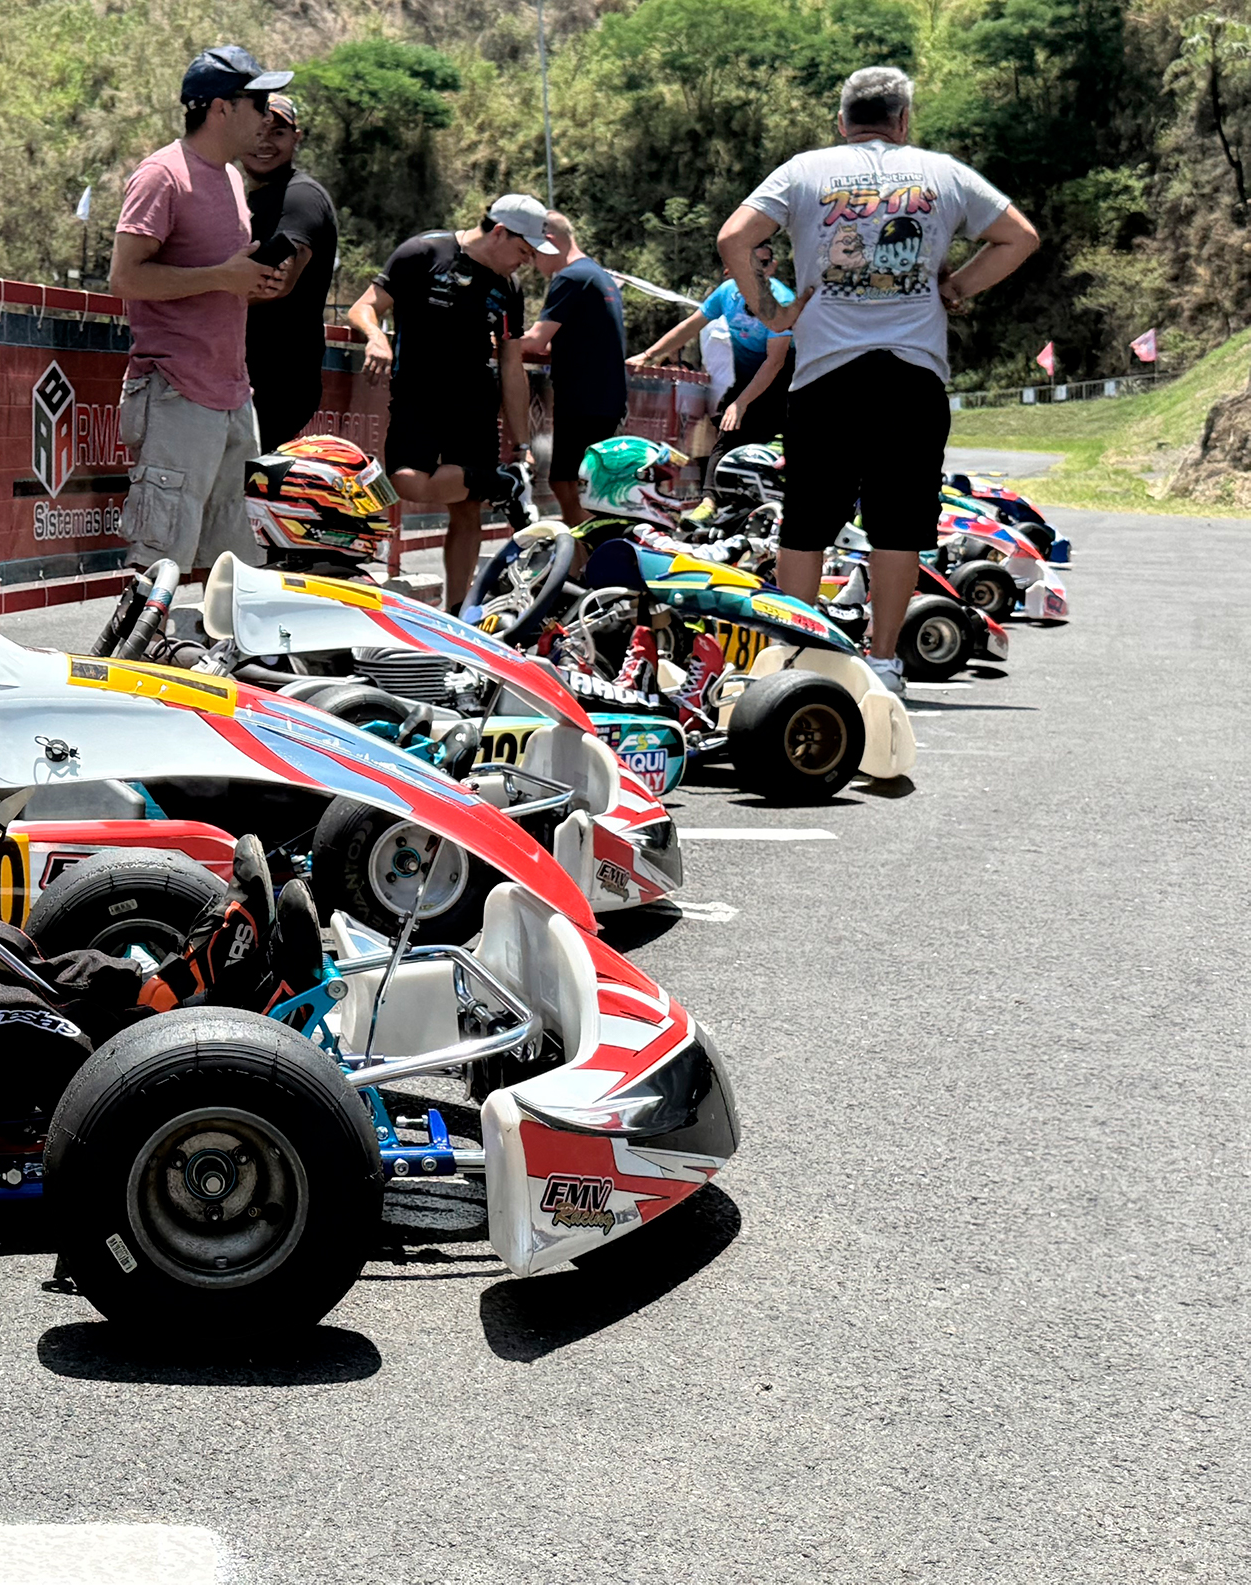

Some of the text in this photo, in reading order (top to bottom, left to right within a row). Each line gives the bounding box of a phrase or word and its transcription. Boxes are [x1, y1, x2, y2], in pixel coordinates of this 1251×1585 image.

[34, 498, 121, 541] Sistemas de
[542, 1176, 613, 1211] FMV
[553, 1202, 615, 1235] Racing
